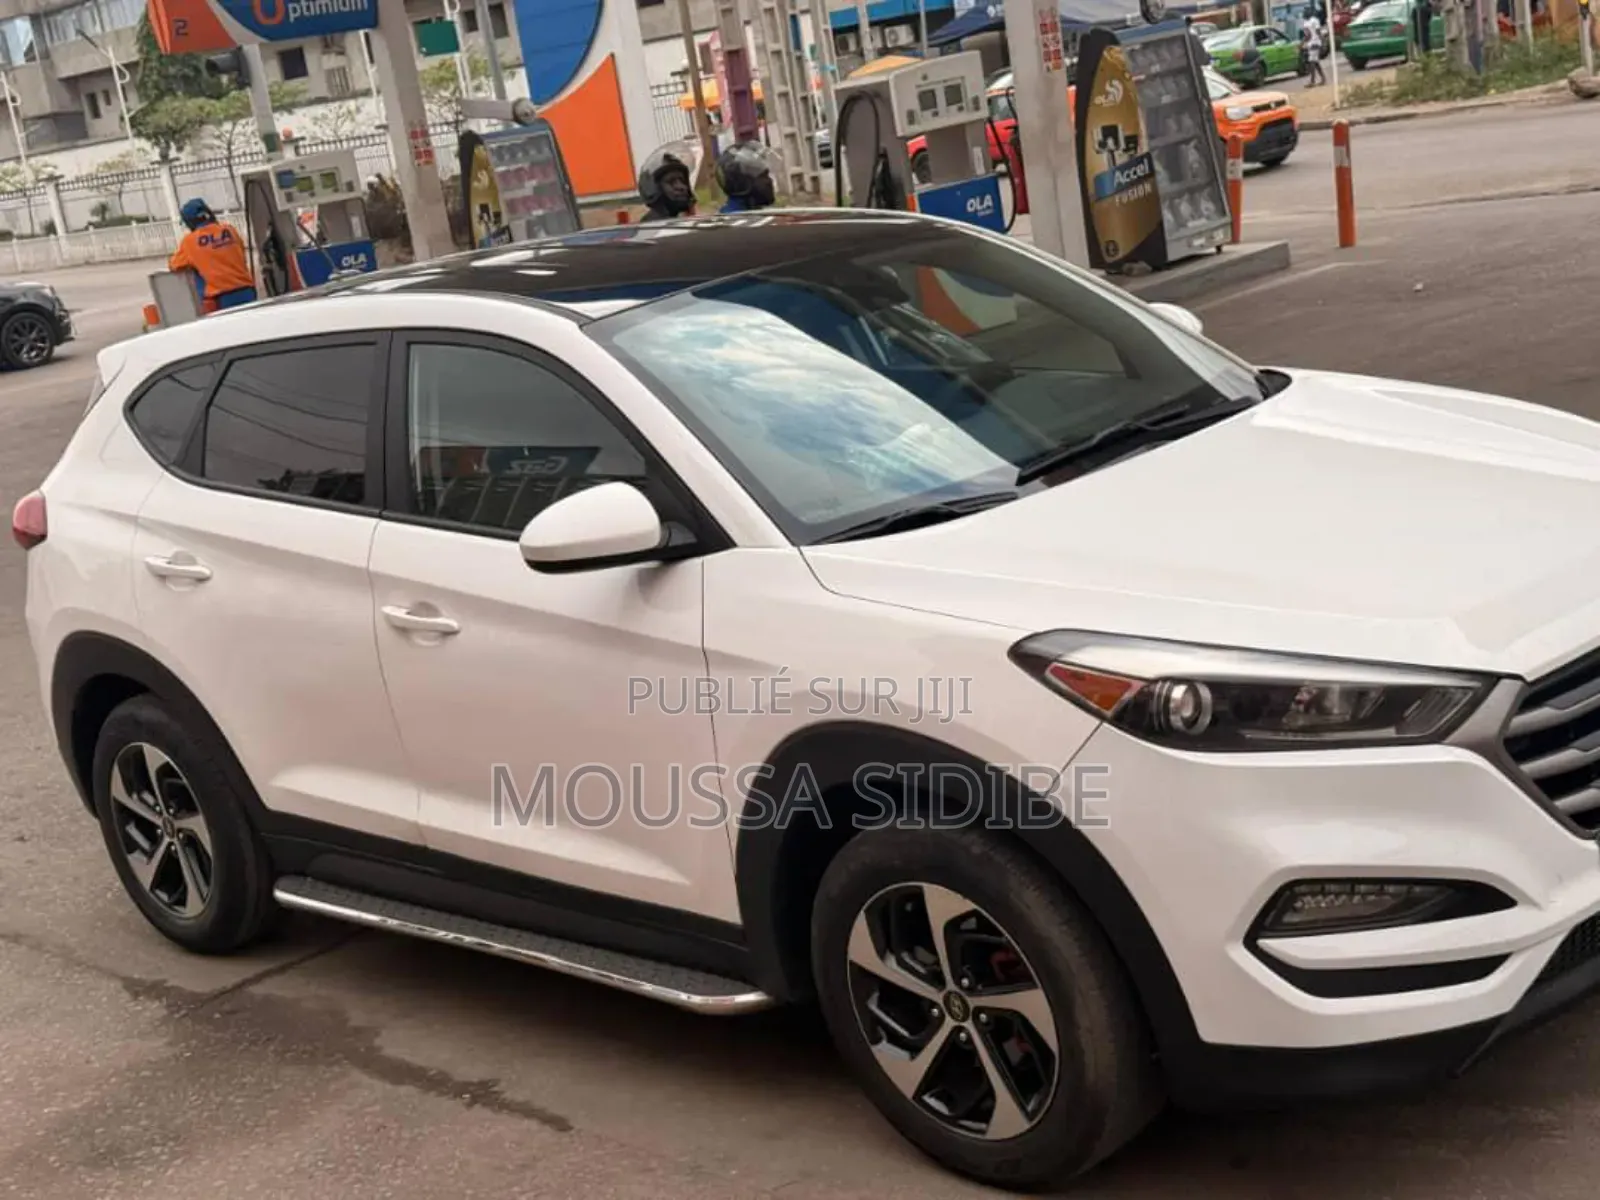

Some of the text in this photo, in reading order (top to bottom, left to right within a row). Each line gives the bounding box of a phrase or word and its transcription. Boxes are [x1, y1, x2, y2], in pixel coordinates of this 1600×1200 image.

[173, 18, 188, 36] 2
[1113, 158, 1149, 189] Accel
[966, 194, 993, 212] OLA
[1114, 183, 1151, 207] FUSION
[198, 228, 233, 247] OLA
[341, 253, 367, 267] OLA
